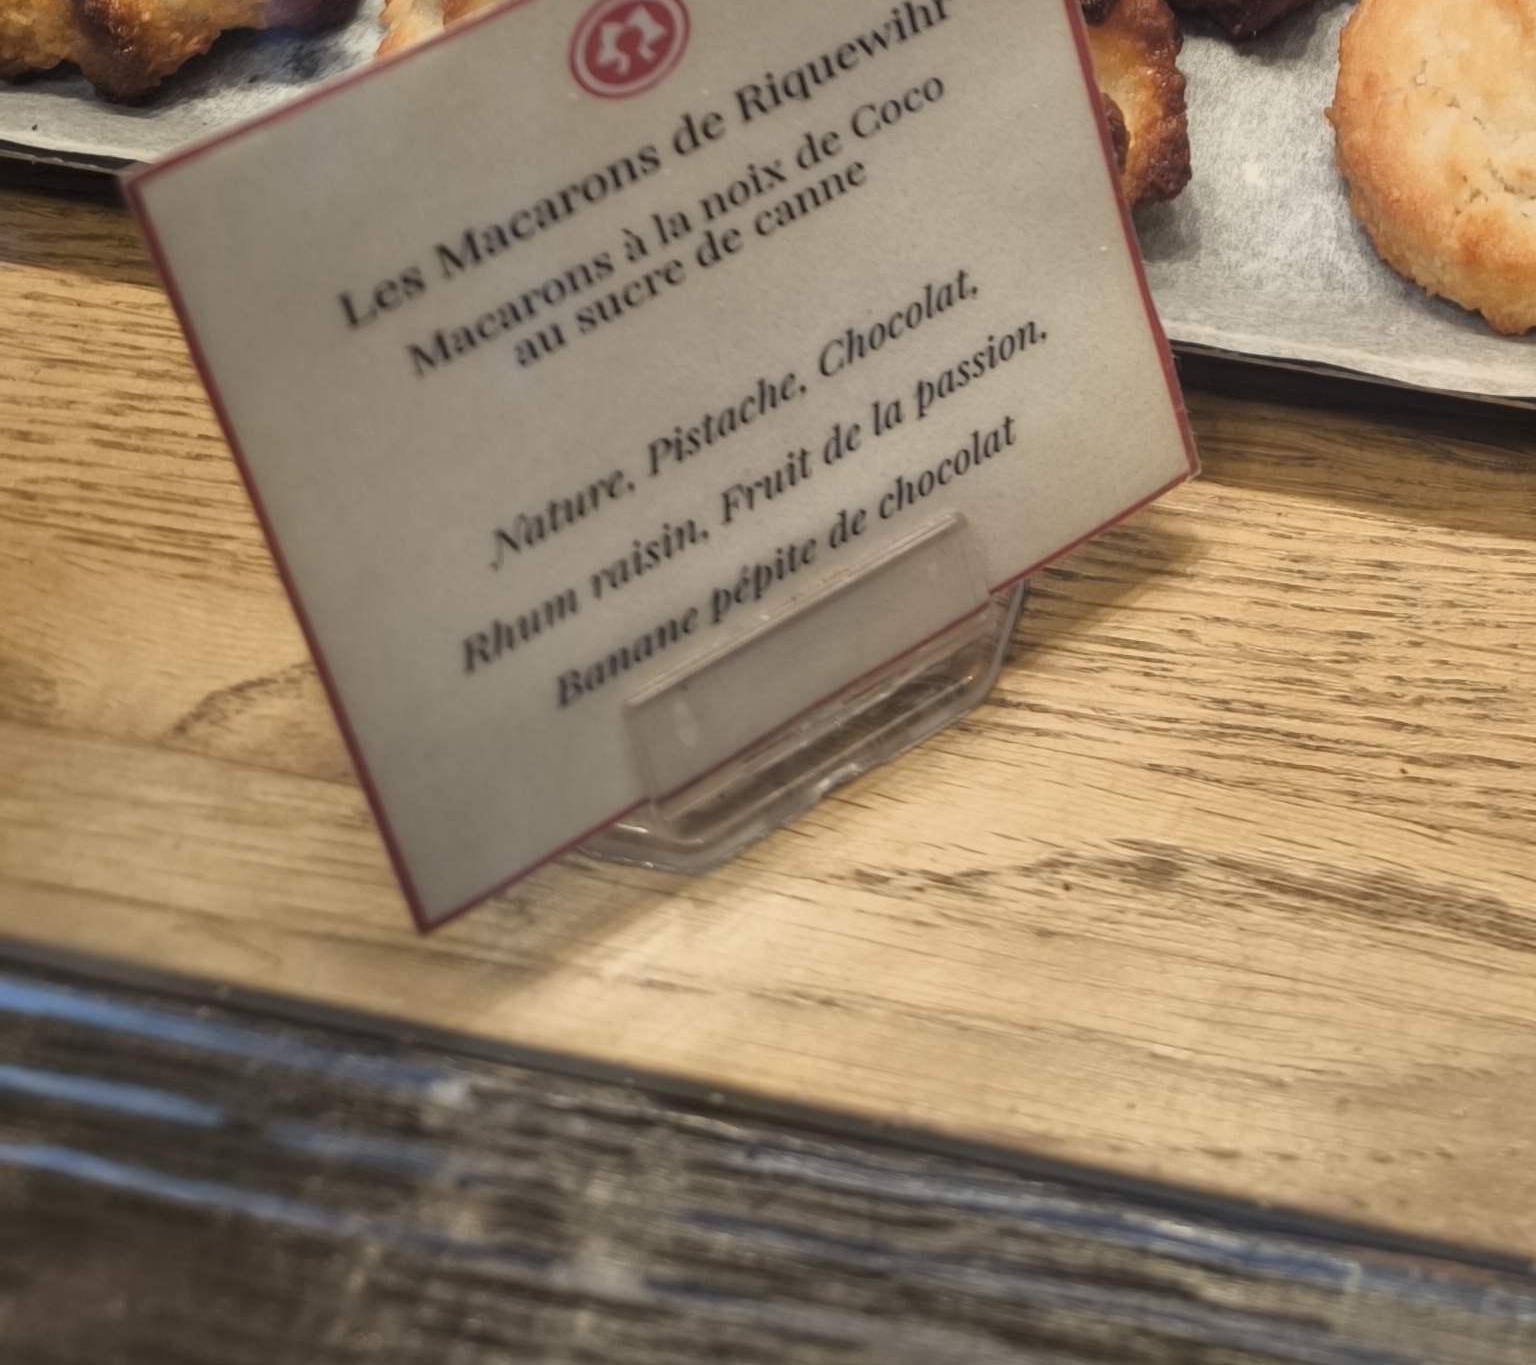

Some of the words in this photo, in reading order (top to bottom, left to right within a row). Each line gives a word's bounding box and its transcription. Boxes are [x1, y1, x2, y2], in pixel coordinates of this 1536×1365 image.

[336, 266, 427, 332] Les
[434, 145, 661, 279] Macarons
[672, 112, 724, 156] de
[406, 251, 615, 379] Macarons
[623, 229, 649, 263] à
[655, 212, 693, 246] la
[699, 160, 787, 222] noix
[796, 131, 840, 170] de
[850, 77, 944, 139] Coco
[515, 323, 566, 367] au
[575, 260, 683, 334] sucre
[695, 225, 746, 268] de
[753, 161, 867, 238] canne
[463, 589, 578, 674] Rhum
[721, 448, 811, 525] Fruit
[823, 423, 861, 465] de
[871, 399, 903, 437] la
[558, 607, 700, 709] Banane
[707, 538, 818, 627] pépite
[826, 508, 867, 551] de
[877, 416, 1015, 521] chocolat
